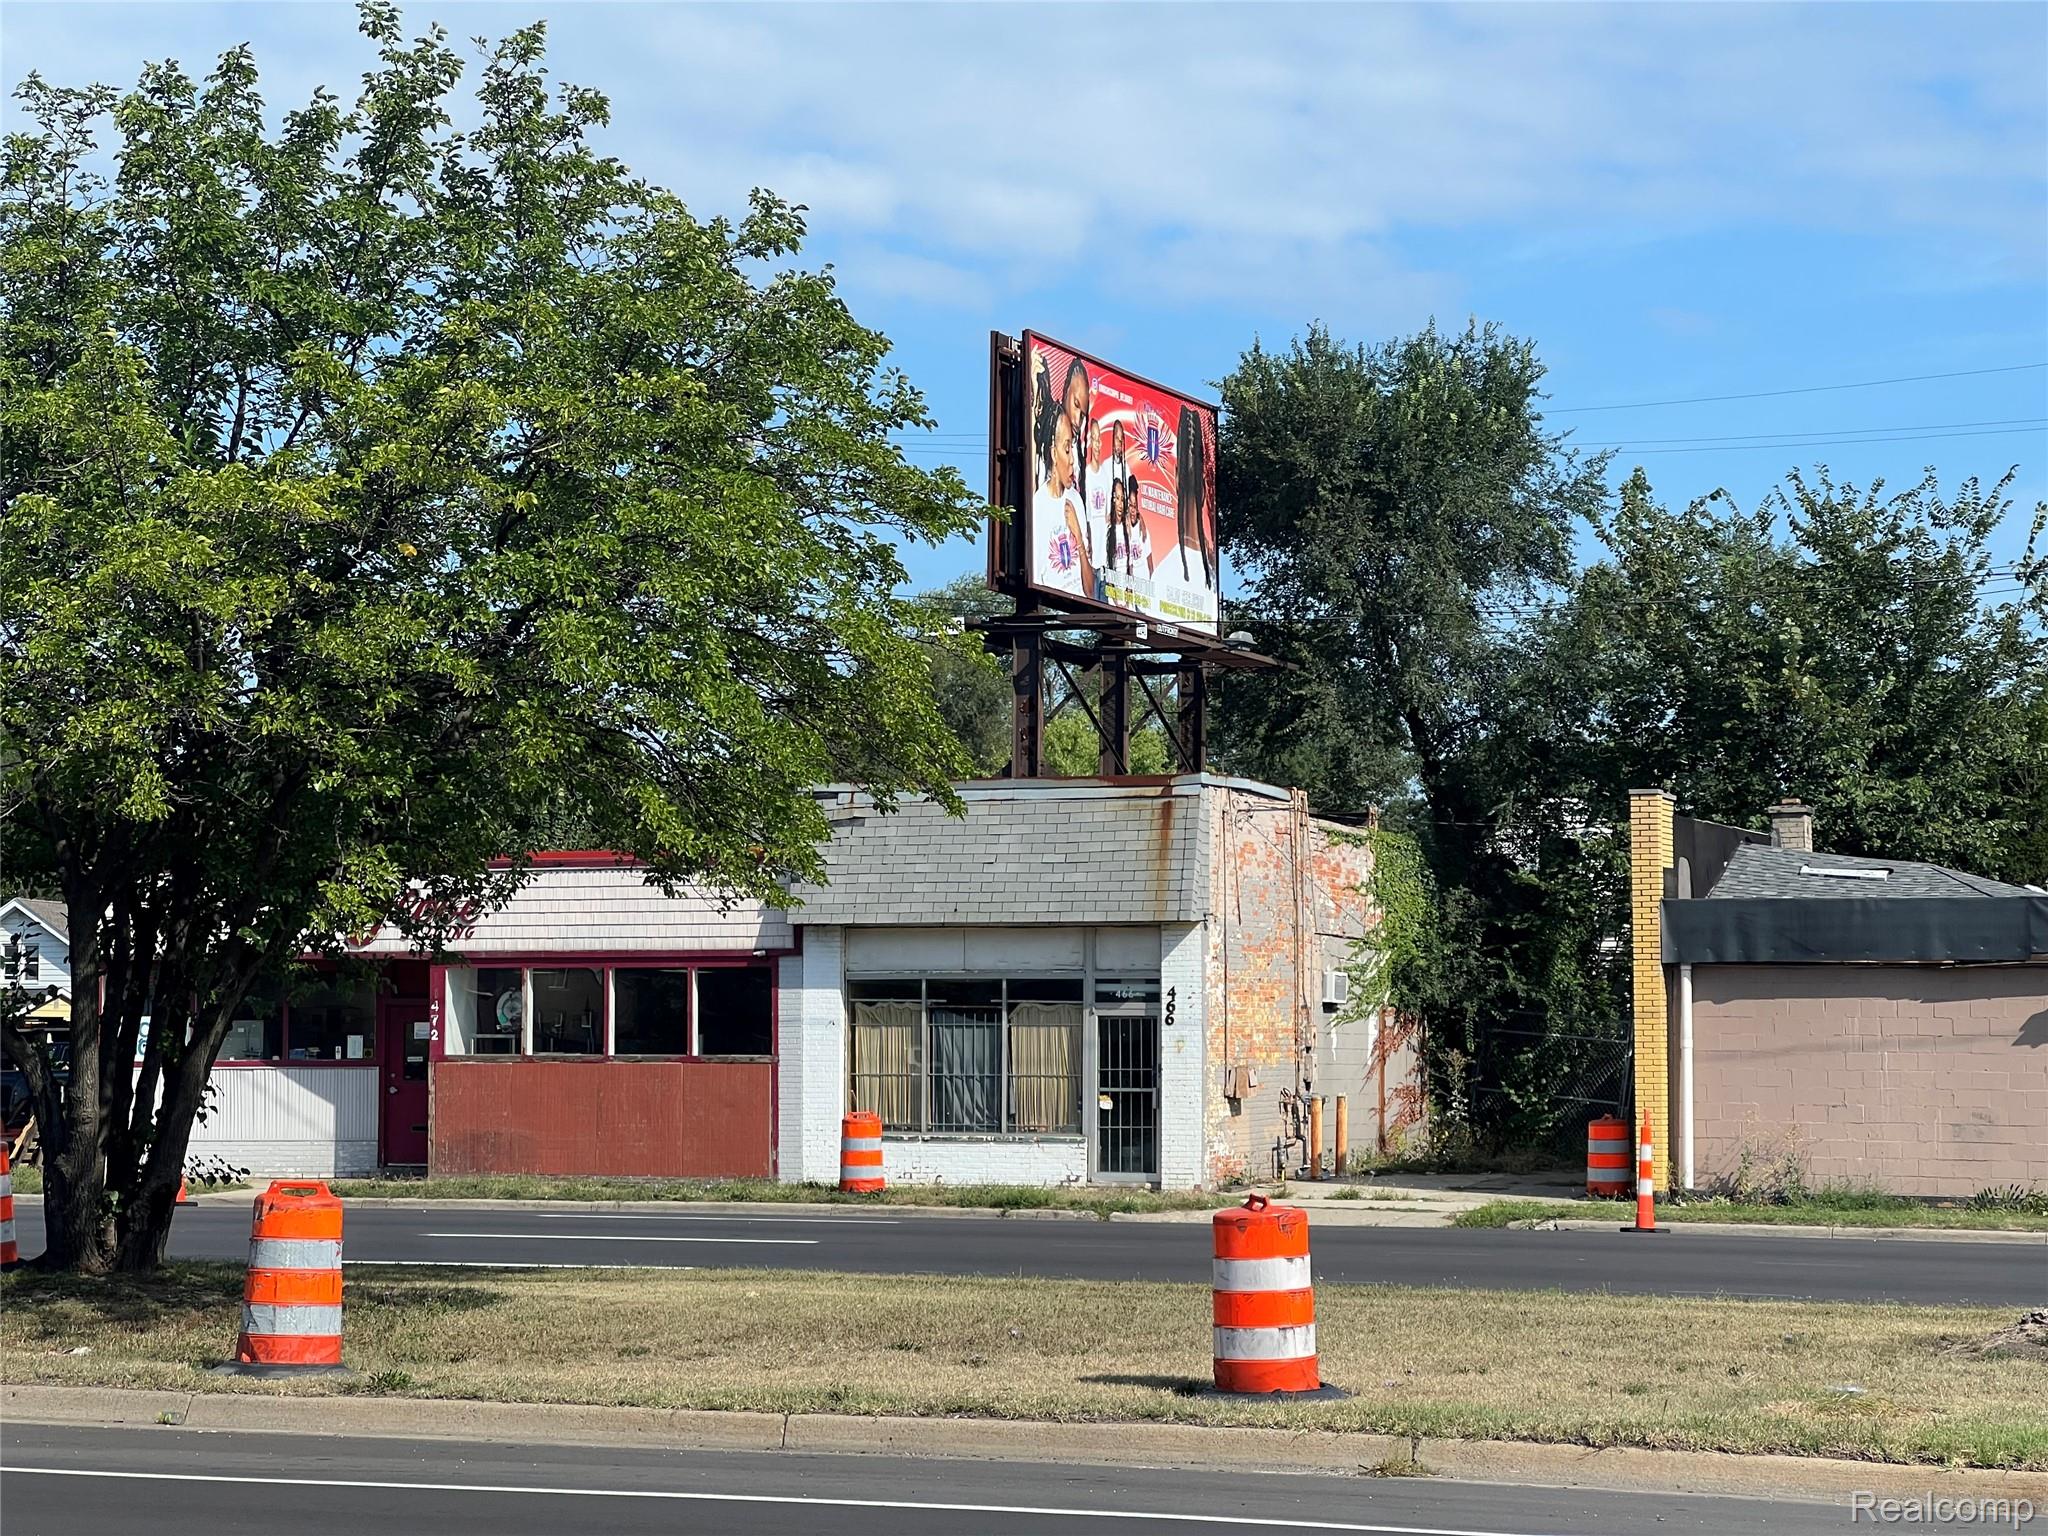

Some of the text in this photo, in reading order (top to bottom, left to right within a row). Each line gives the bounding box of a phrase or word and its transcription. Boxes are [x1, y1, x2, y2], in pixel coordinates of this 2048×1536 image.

[1115, 990, 1134, 998] 466
[1165, 985, 1177, 1026] 466
[430, 1000, 439, 1041] 472
